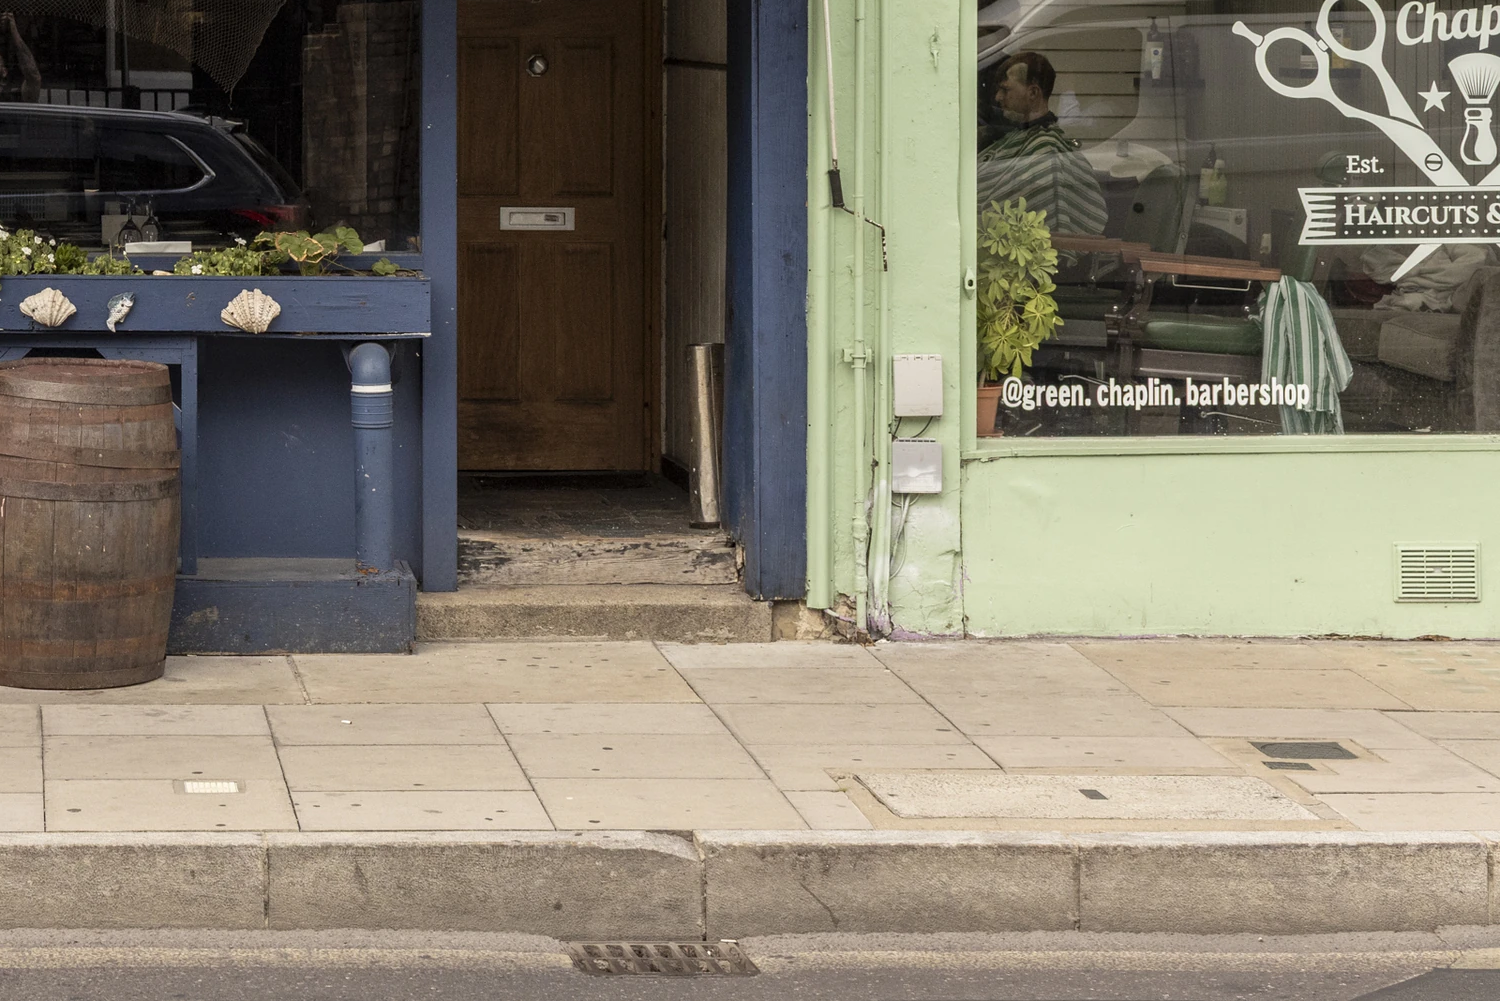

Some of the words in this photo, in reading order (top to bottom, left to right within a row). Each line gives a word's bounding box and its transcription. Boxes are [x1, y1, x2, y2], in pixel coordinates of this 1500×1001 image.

[1396, 0, 1500, 51] Chap
[1346, 155, 1385, 174] Est.
[1096, 377, 1181, 411] chaplin.
[1186, 377, 1310, 410] barbershop
